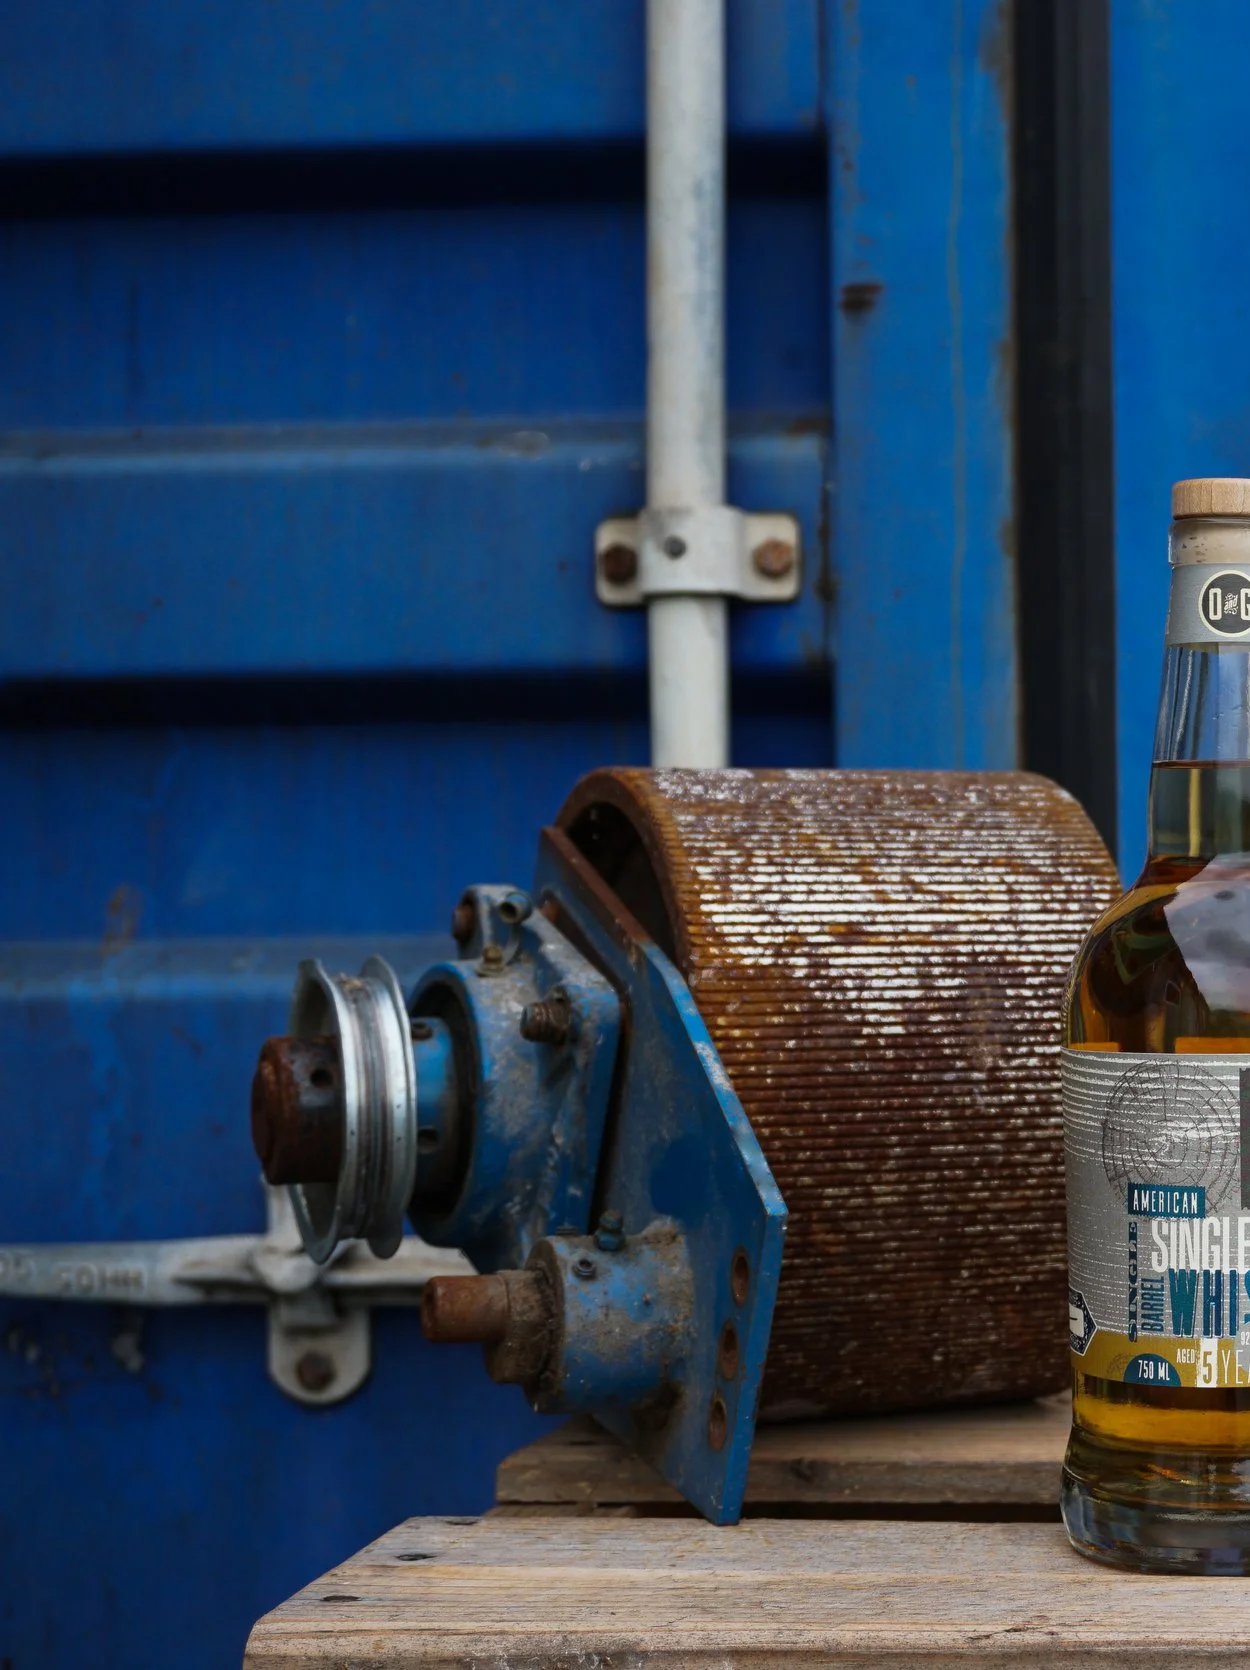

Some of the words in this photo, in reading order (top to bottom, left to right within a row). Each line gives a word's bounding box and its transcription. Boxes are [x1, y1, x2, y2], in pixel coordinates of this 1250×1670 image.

[1132, 1188, 1199, 1215] AMERICAN
[1127, 1221, 1138, 1343] SINGLE
[1140, 1275, 1165, 1333] BARREL
[1137, 1360, 1155, 1380] 750
[1157, 1362, 1171, 1381] ML
[1176, 1348, 1196, 1364] AGED
[1202, 1350, 1213, 1385] 5
